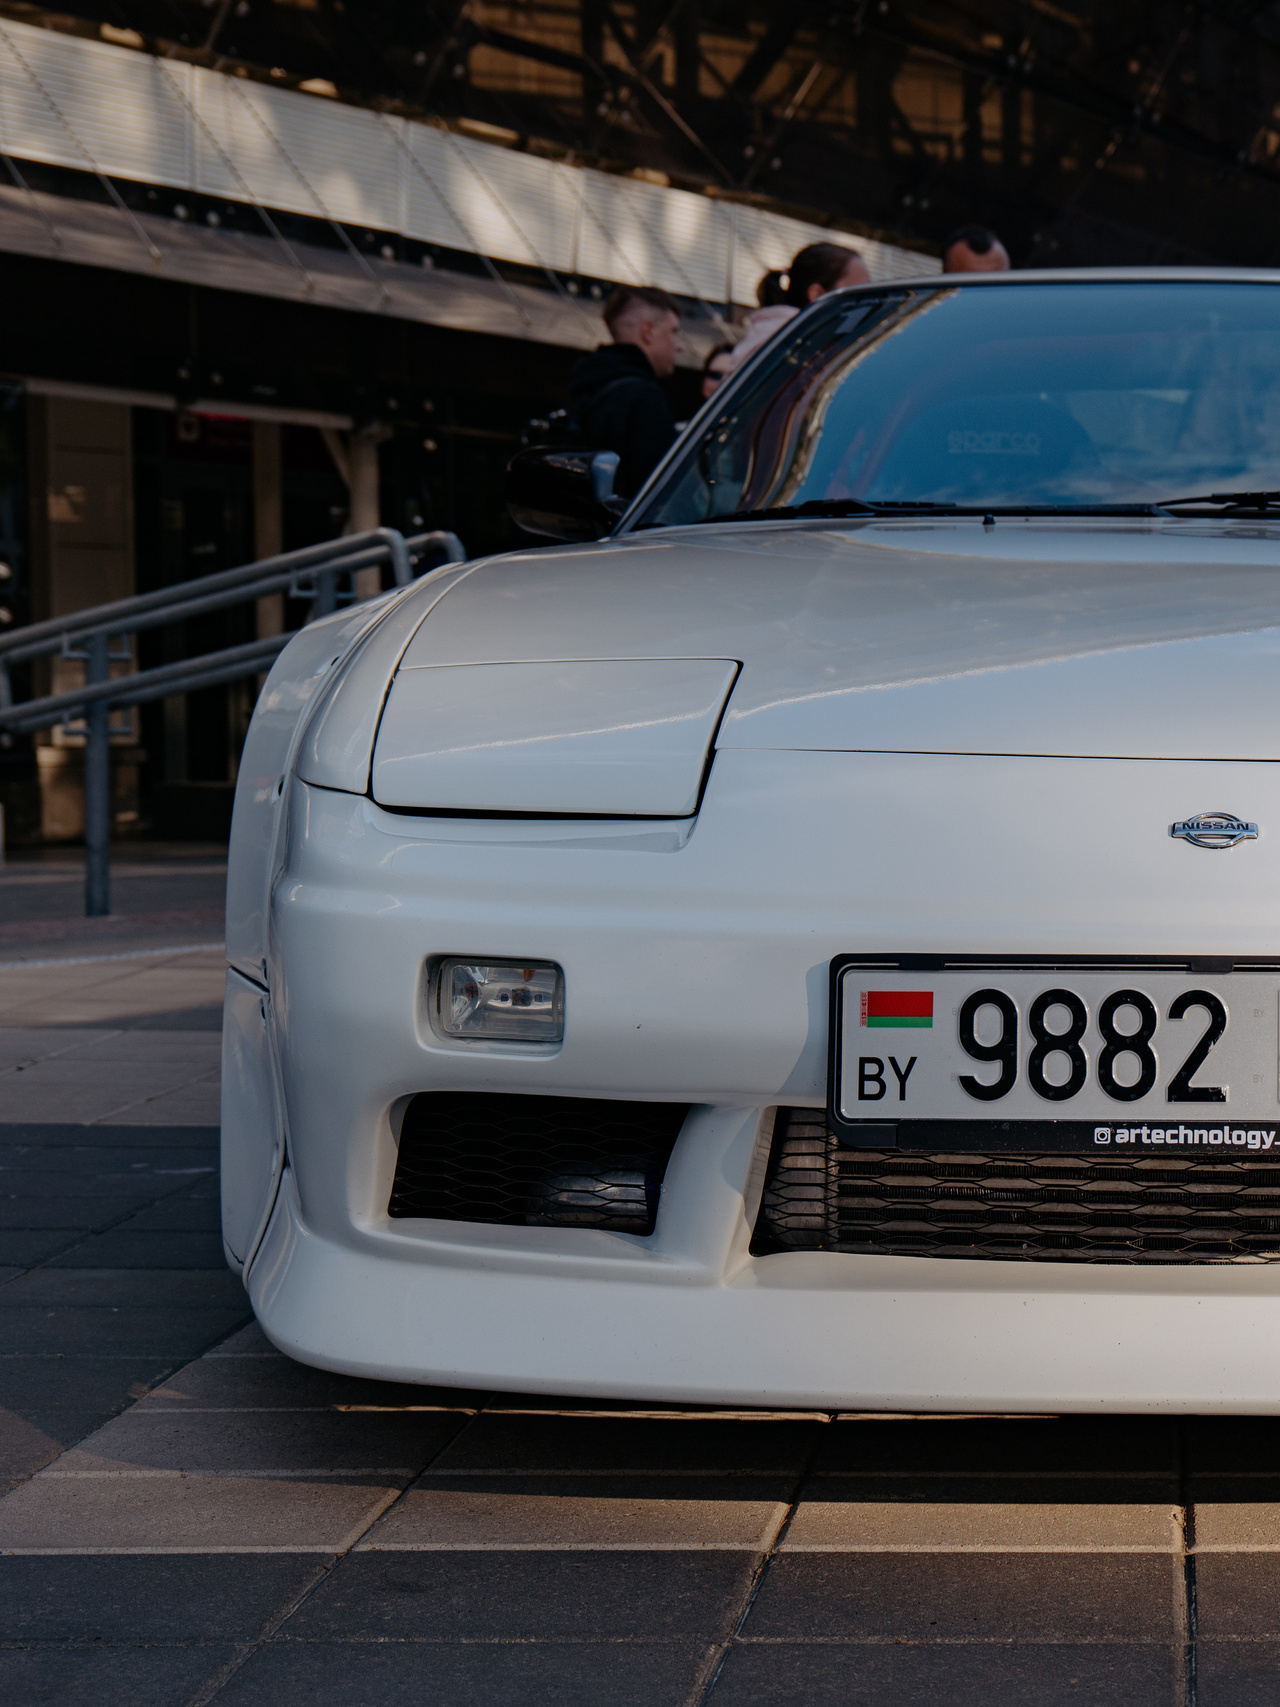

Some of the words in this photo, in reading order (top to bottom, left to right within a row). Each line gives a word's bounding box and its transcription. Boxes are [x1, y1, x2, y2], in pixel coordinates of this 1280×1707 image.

[1182, 821, 1250, 831] NISSAN
[958, 988, 1227, 1103] 9882
[857, 1056, 918, 1102] BY
